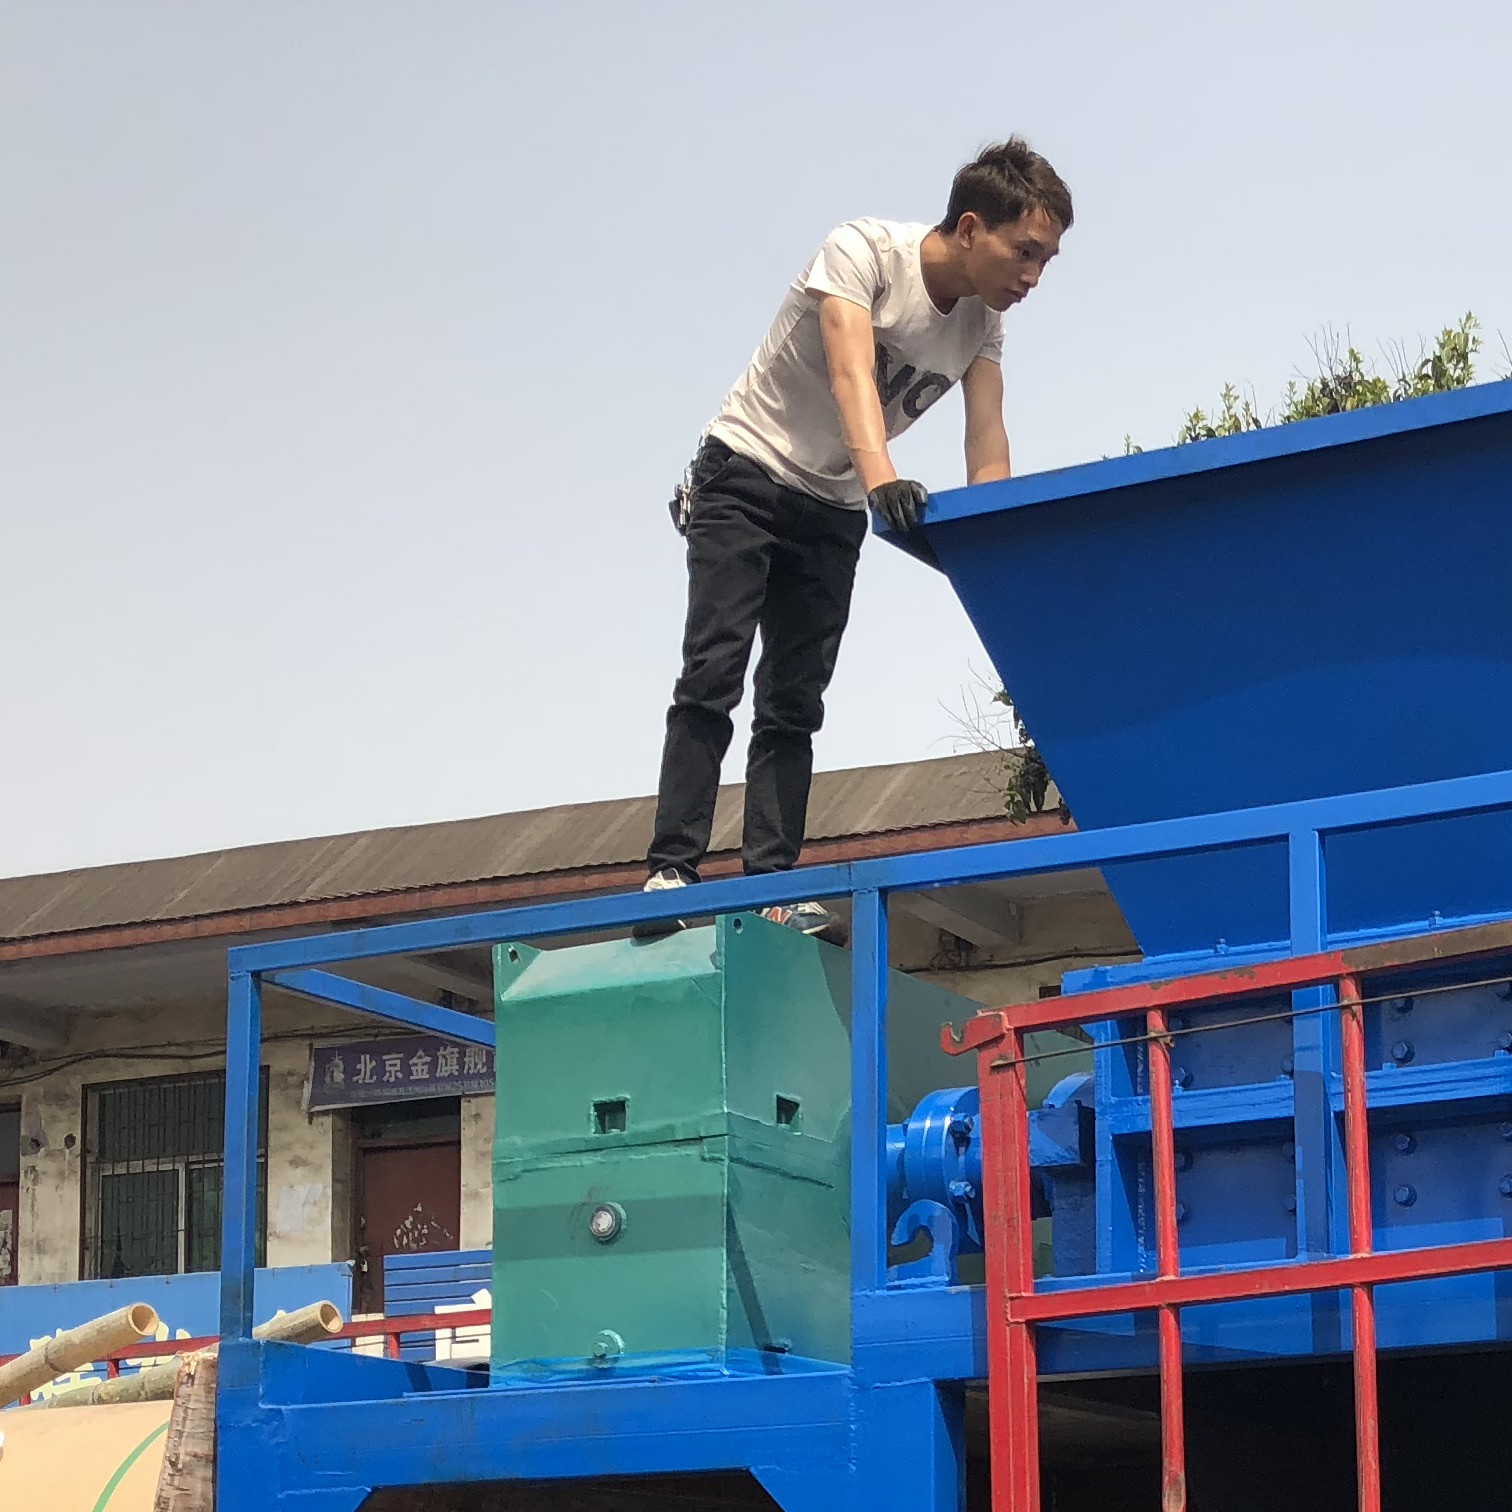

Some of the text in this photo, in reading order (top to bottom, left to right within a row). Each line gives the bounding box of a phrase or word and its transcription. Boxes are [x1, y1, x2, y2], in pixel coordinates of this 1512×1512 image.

[353, 1046, 495, 1084] 北京金旗舰
